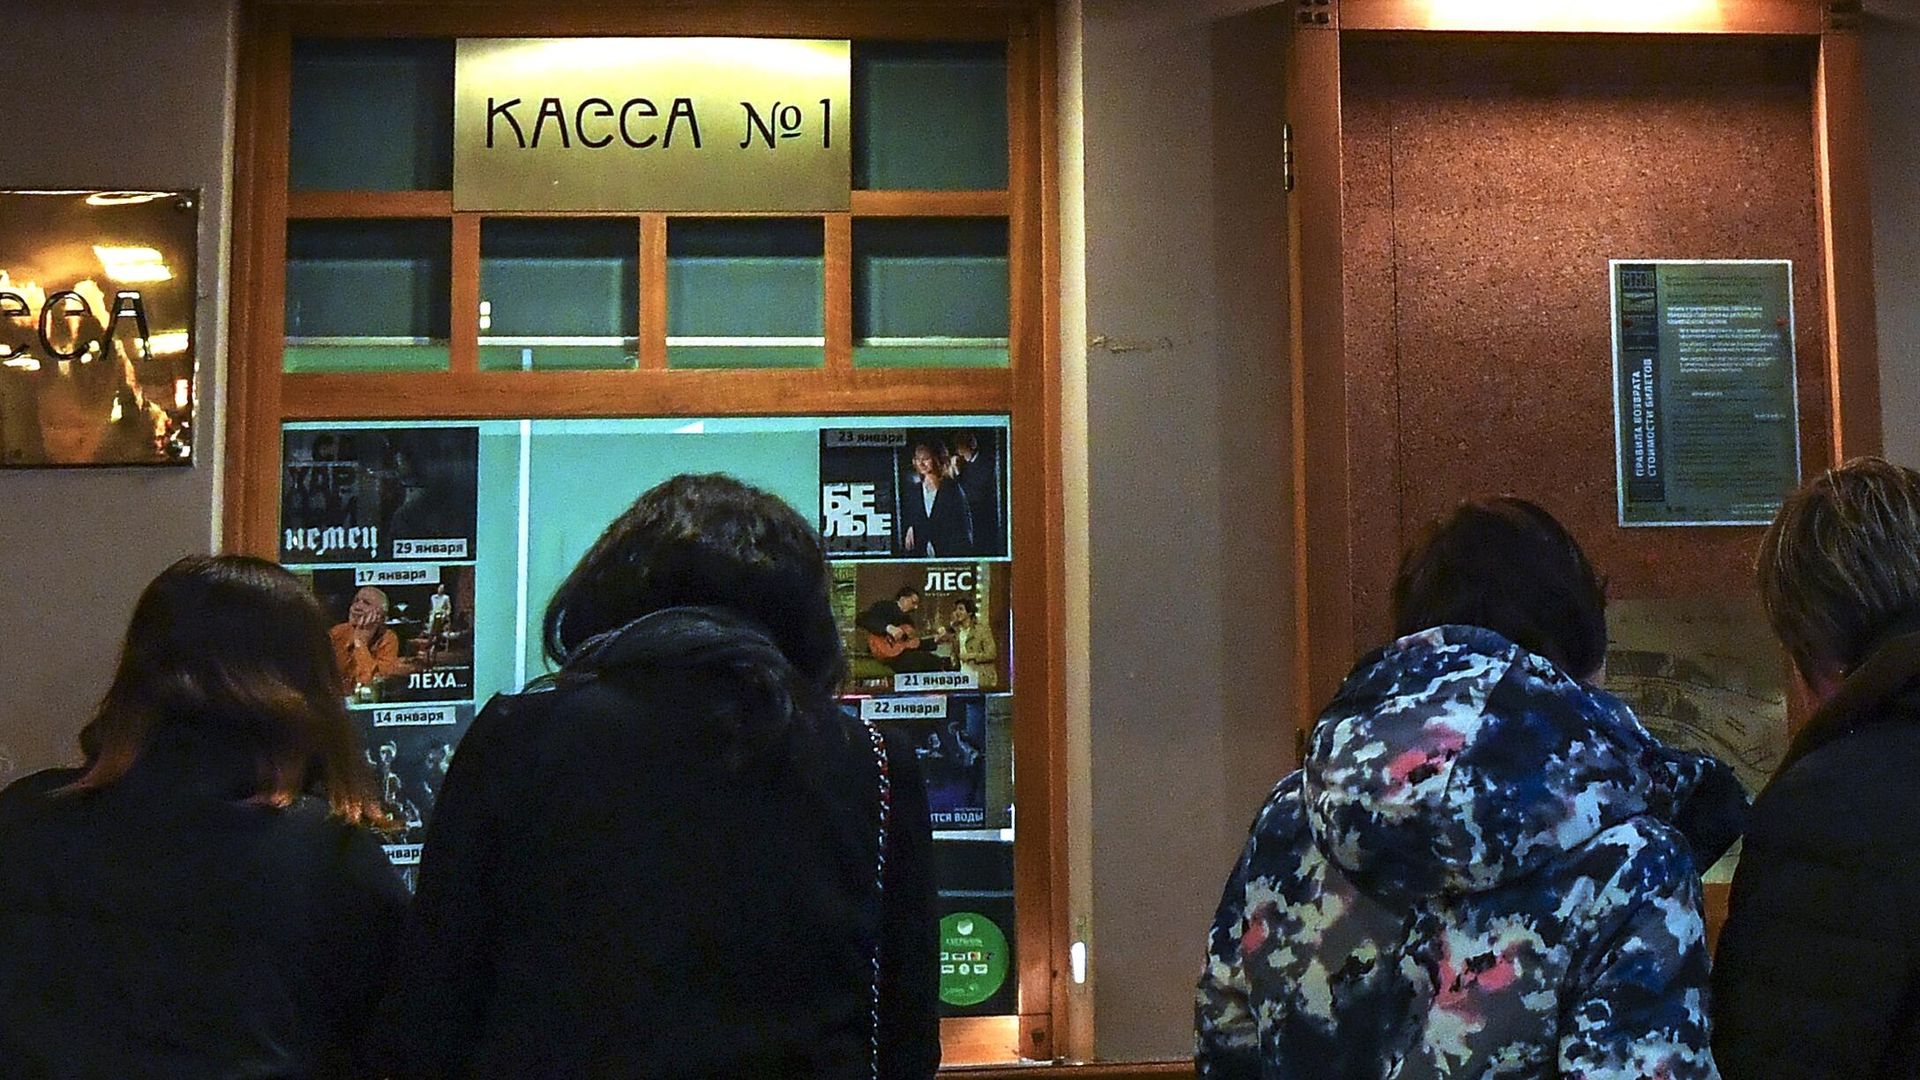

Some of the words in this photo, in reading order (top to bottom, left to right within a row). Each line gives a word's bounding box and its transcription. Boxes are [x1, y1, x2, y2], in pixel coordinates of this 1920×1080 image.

[485, 97, 702, 149] КАССА
[819, 98, 831, 149] 1
[1643, 358, 1654, 407] БИЛЕТОВ
[1631, 370, 1642, 424] ВОЗВРАТА
[838, 432, 854, 443] 23
[1645, 408, 1657, 477] СТОИМОСТИ
[1634, 428, 1644, 477] ПРАВИЛА
[823, 482, 875, 515] БЕ
[395, 543, 412, 555] 29
[415, 541, 464, 556] января
[358, 570, 374, 582] 17
[377, 569, 427, 582] января
[924, 571, 973, 592] ЛЕС
[904, 675, 919, 686] 21
[922, 674, 970, 688] января
[375, 712, 392, 724] 14
[395, 711, 444, 724] января
[874, 702, 890, 713] 22
[893, 702, 940, 716] января
[954, 811, 984, 823] ВОДЫ
